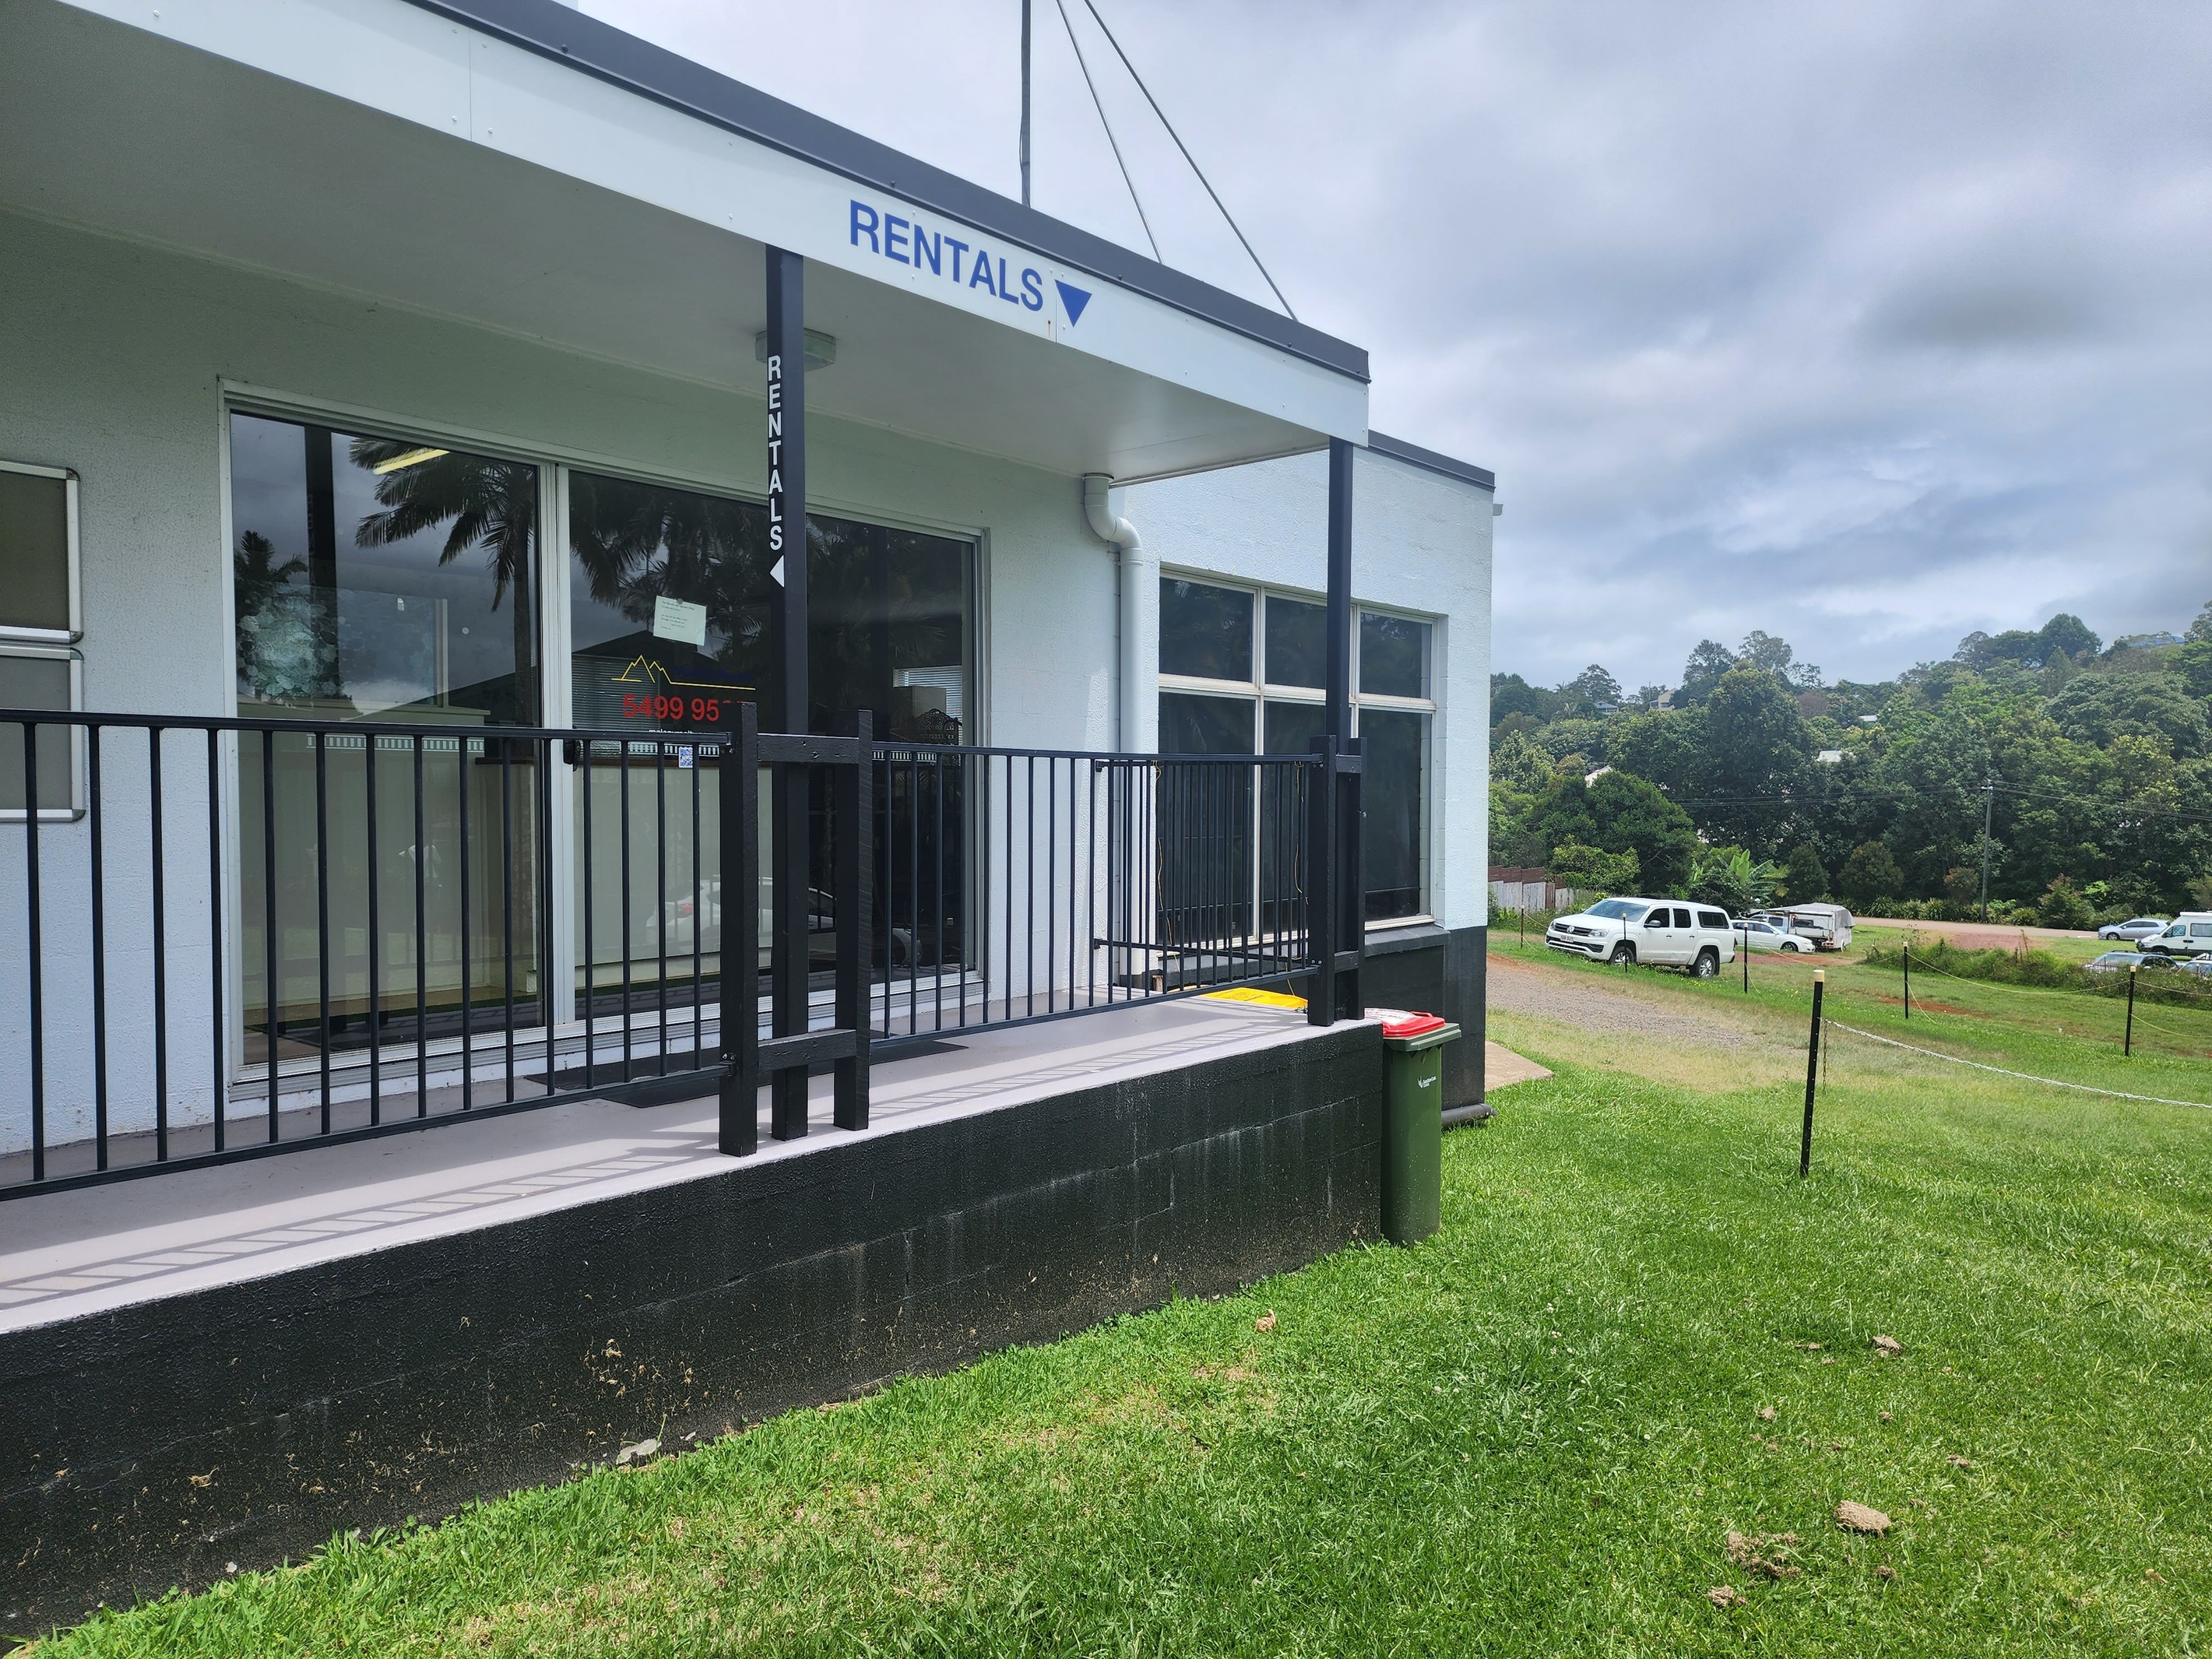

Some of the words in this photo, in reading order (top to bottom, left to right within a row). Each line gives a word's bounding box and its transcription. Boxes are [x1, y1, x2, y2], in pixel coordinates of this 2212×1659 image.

[849, 199, 1044, 312] RENTALS
[768, 355, 783, 551] RENTALS
[623, 693, 684, 721] 5499
[691, 698, 743, 722] 95
